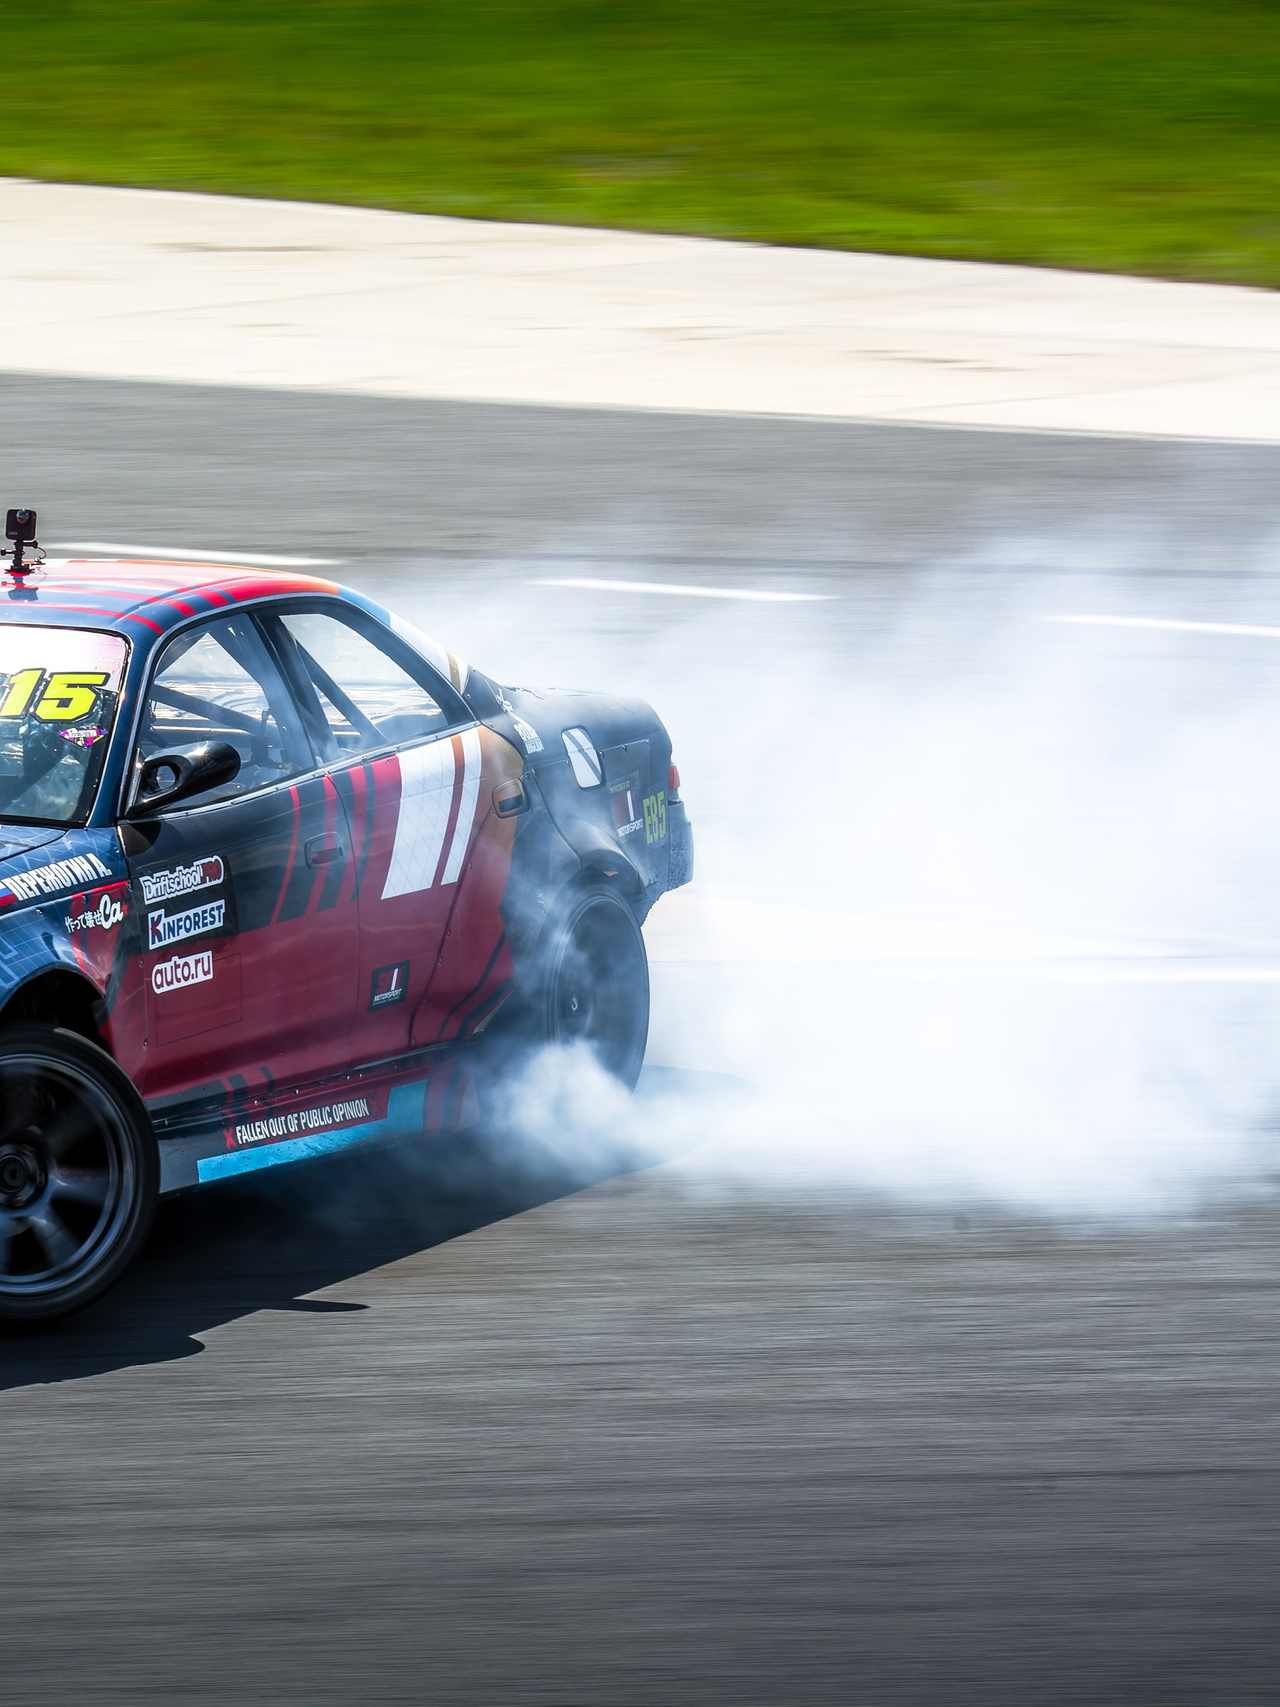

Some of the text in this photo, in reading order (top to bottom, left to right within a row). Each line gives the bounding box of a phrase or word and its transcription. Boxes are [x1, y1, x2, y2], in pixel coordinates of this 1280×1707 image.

[643, 791, 666, 844] E85
[1, 855, 98, 901] ПЕРЕЖОГИН
[154, 955, 211, 990] auto.ru
[235, 1098, 370, 1145] FALLEN OUT OF PUBLIC OPINION
